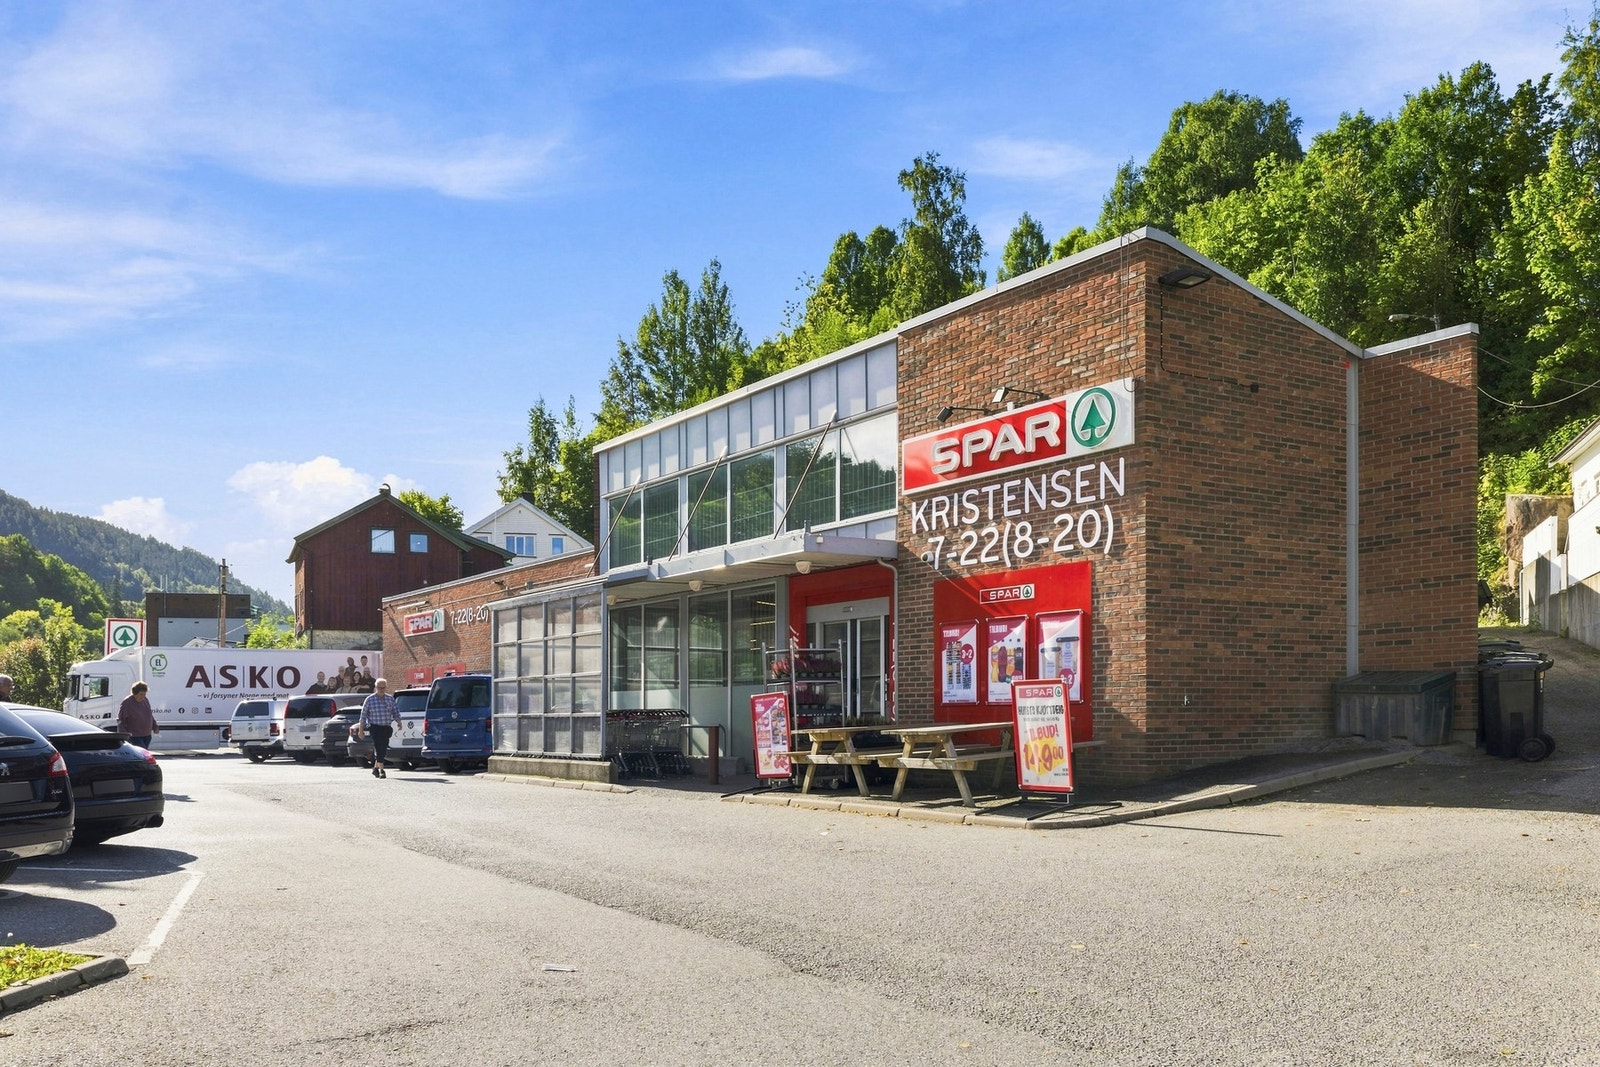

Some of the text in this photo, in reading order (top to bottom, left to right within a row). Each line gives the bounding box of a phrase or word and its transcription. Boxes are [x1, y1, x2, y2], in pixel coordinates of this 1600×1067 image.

[931, 411, 1061, 475] SPAR
[911, 457, 1125, 534] KRISTENSEN
[927, 504, 1114, 570] 7-22(8-20)
[989, 588, 1020, 600] SPAR
[210, 692, 238, 701] forsyner
[1025, 688, 1053, 697] SPAR
[1029, 724, 1059, 742] ILBUD!
